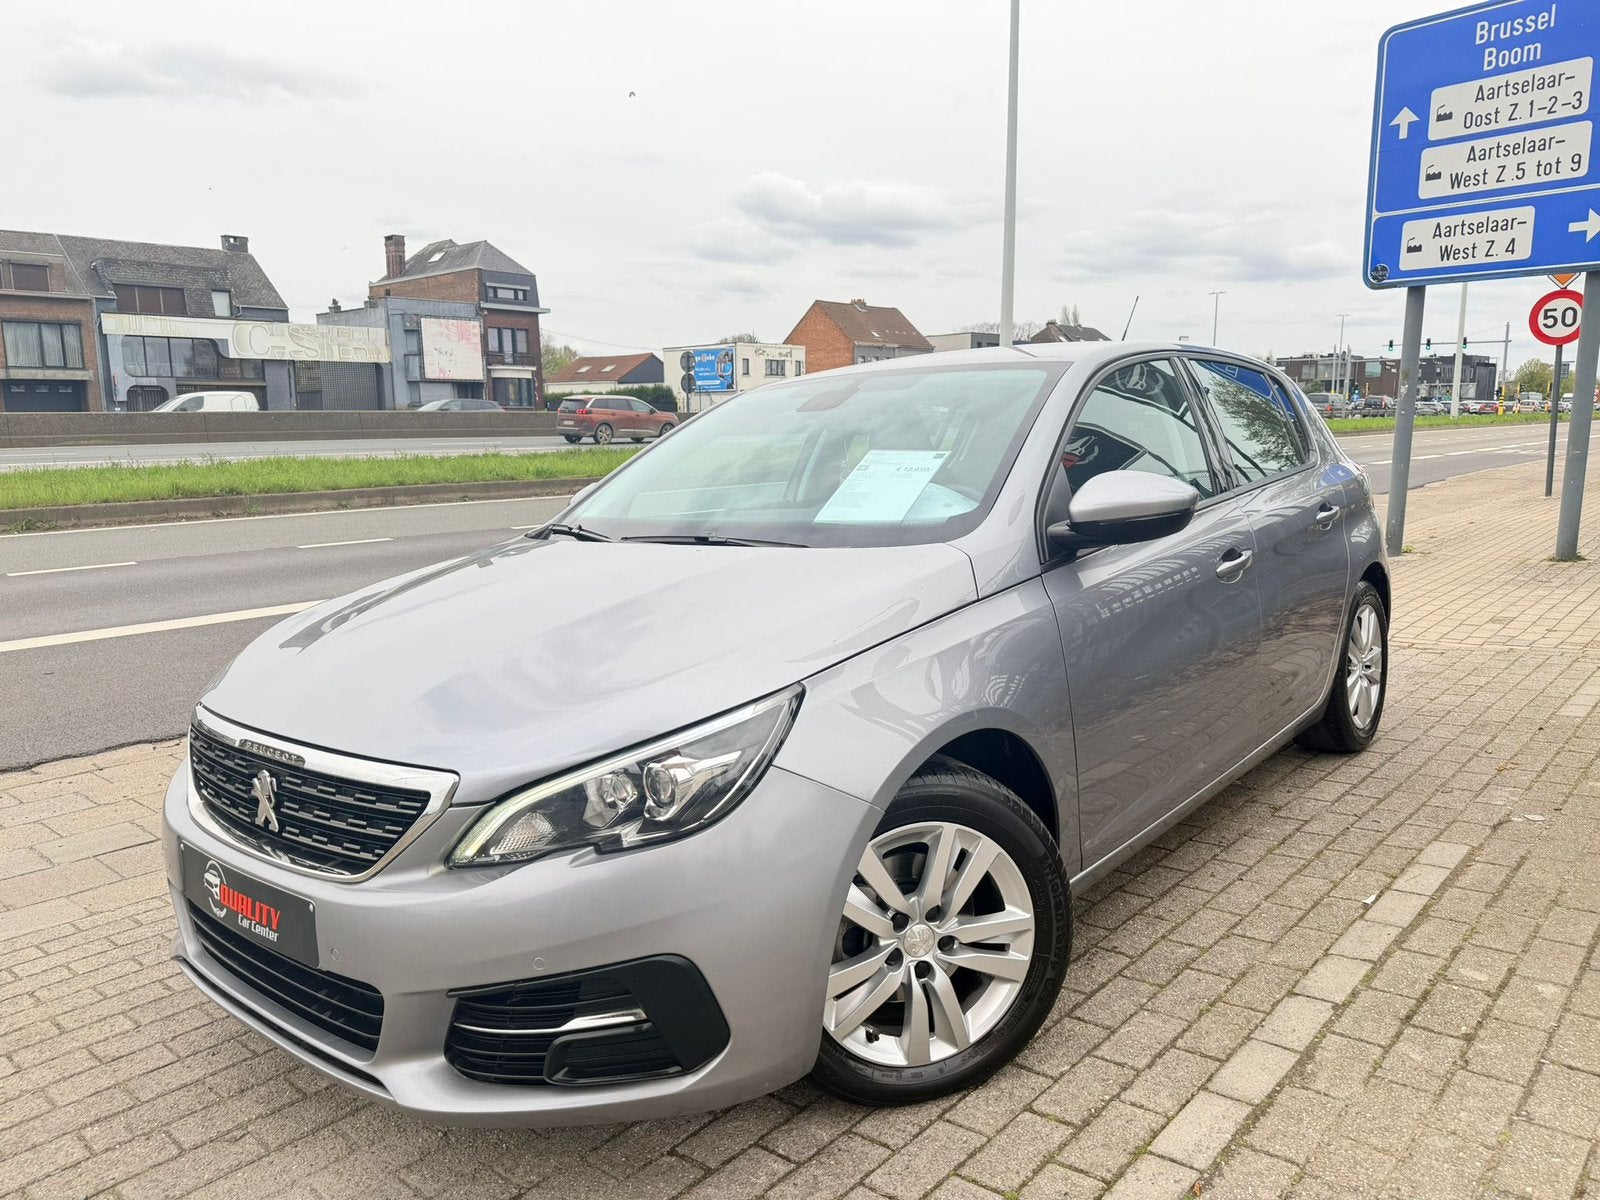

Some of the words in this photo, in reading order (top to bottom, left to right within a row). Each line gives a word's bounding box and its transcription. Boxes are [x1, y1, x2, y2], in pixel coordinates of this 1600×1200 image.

[1475, 4, 1556, 45] Brussel
[1483, 42, 1541, 71] Boom
[1474, 72, 1575, 103] Aartselaar-
[1464, 106, 1500, 129] Oost
[1467, 136, 1566, 163] Aartselaar-
[1450, 168, 1488, 189] West
[1536, 156, 1562, 177] tot
[1570, 153, 1582, 172] 9
[1432, 216, 1527, 239] Aartselaar-
[1440, 242, 1478, 262] West
[1543, 306, 1578, 329] 50
[244, 741, 297, 764] PEUGEOT
[220, 883, 281, 931] QUALITY
[238, 914, 251, 929] Car
[251, 920, 280, 942] Center
